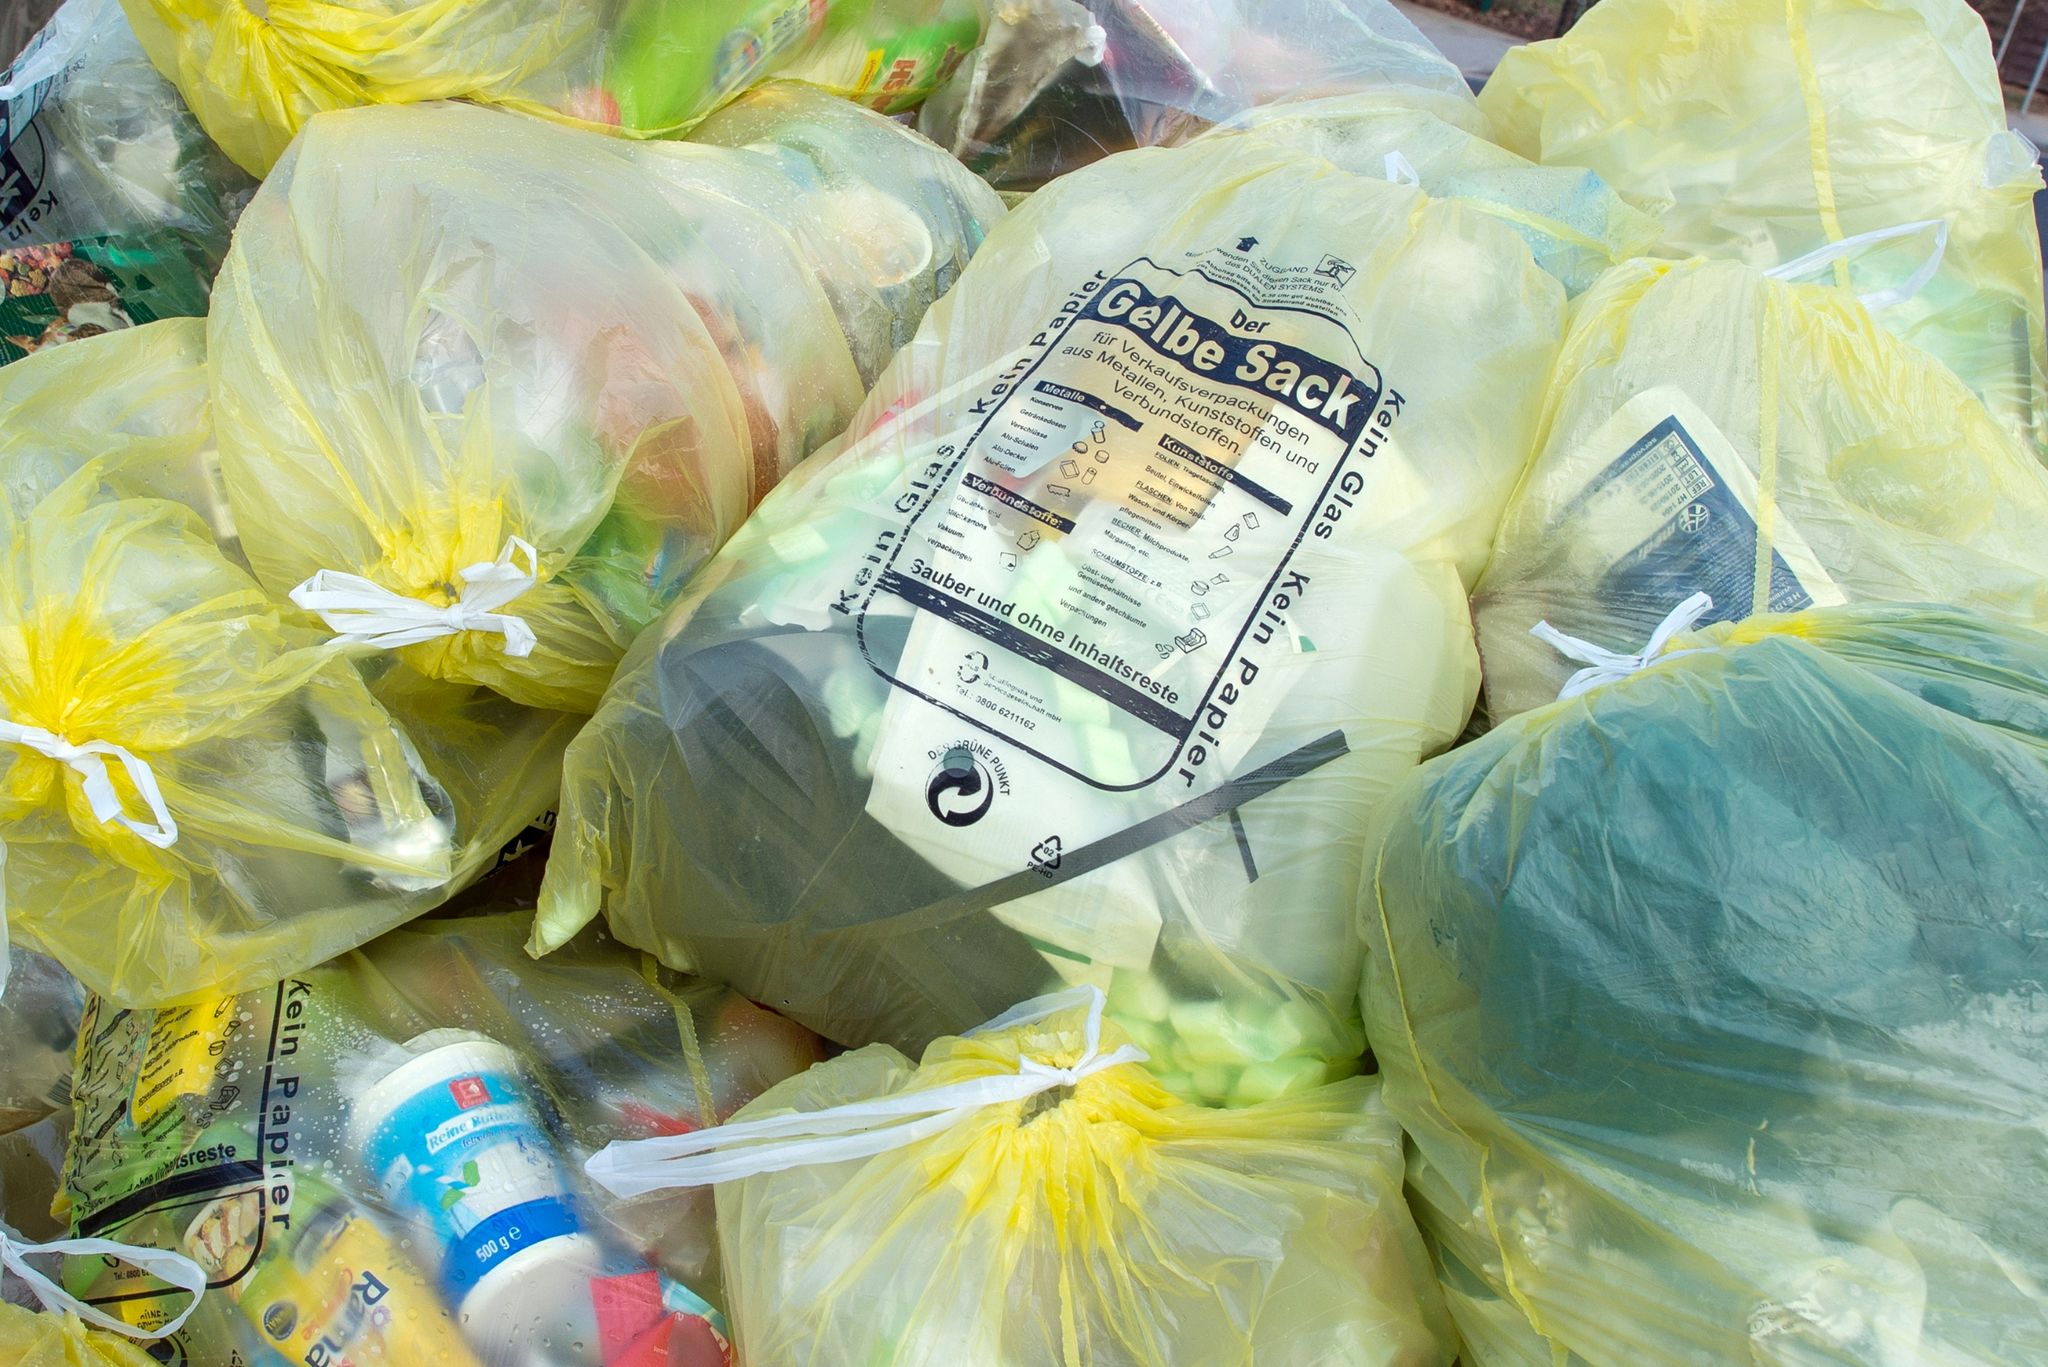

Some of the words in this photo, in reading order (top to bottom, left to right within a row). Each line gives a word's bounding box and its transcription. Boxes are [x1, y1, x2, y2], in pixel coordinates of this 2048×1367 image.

[8, 190, 58, 242] Kein
[1224, 260, 1241, 269] des
[1242, 264, 1277, 291] DUALEN
[1278, 283, 1324, 294] SYSTEMS
[1258, 256, 1309, 275] ZUGBAND
[1291, 275, 1313, 283] Sack
[1229, 307, 1271, 333] Der
[1095, 276, 1227, 370] Gelbe
[1236, 339, 1363, 431] Sack
[1041, 383, 1086, 403] Metalle
[1091, 329, 1120, 349] für
[1121, 339, 1311, 446] Verkaufsverpackungen
[1018, 407, 1067, 430] Getränkedosen
[1029, 395, 1064, 412] Konserven
[1061, 345, 1094, 360] aus
[1095, 348, 1170, 403] Metallen,
[1174, 393, 1283, 454] Kunststoffen
[1284, 449, 1320, 475] und
[1114, 379, 1246, 457] Verbundstoffen.
[1010, 419, 1049, 440] Verschlüsse
[1357, 387, 1407, 460] Kein
[829, 526, 896, 615] Kein
[892, 441, 955, 517] Glas
[967, 354, 1032, 422] Kein
[1031, 269, 1108, 352] Papier
[991, 443, 1027, 462] Alu-Deckel
[1000, 431, 1039, 452] Alu-Schalen
[982, 455, 1016, 473] Alu-Folien
[1153, 450, 1181, 470] FOLIEN:
[1161, 436, 1235, 482] Kunststoffe
[1134, 480, 1174, 506] FLASCHEN:
[1174, 500, 1189, 512] Von
[1187, 506, 1208, 523] Spül-
[1167, 478, 1217, 509] Einwickelfolien
[1689, 478, 1707, 494] REF
[1118, 505, 1163, 531] pflegemitteln
[1127, 493, 1153, 510] Wasch-
[1151, 505, 1166, 517] und
[1165, 512, 1192, 531] Körper-
[1311, 467, 1368, 542] Glas
[937, 521, 965, 539] Vakuum-
[1110, 516, 1143, 538] BECHER:
[1075, 570, 1142, 608] Gemüsebehältnisse
[1099, 573, 1115, 584] und
[1067, 584, 1082, 595] und
[1081, 591, 1107, 607] andere
[1104, 603, 1148, 629] geschäumte
[1251, 568, 1310, 647] Kein
[908, 557, 976, 600] Sauber
[975, 589, 1016, 618] und
[1014, 608, 1068, 645] ohne
[1067, 633, 1182, 706] Inhaltsreste
[974, 694, 998, 712] 0800
[997, 706, 1037, 731] 6211162
[1044, 710, 1062, 723] mbH
[1175, 657, 1260, 788] Papier
[955, 739, 993, 759] GRÜNE
[989, 755, 1010, 795] PUNKT
[1041, 845, 1055, 858] 02
[1025, 860, 1054, 880] PE-HD
[282, 979, 313, 1056] Kein
[429, 1121, 467, 1149] Reine
[264, 1077, 299, 1231] Papier
[475, 1238, 499, 1262] 500
[498, 1234, 511, 1251] g
